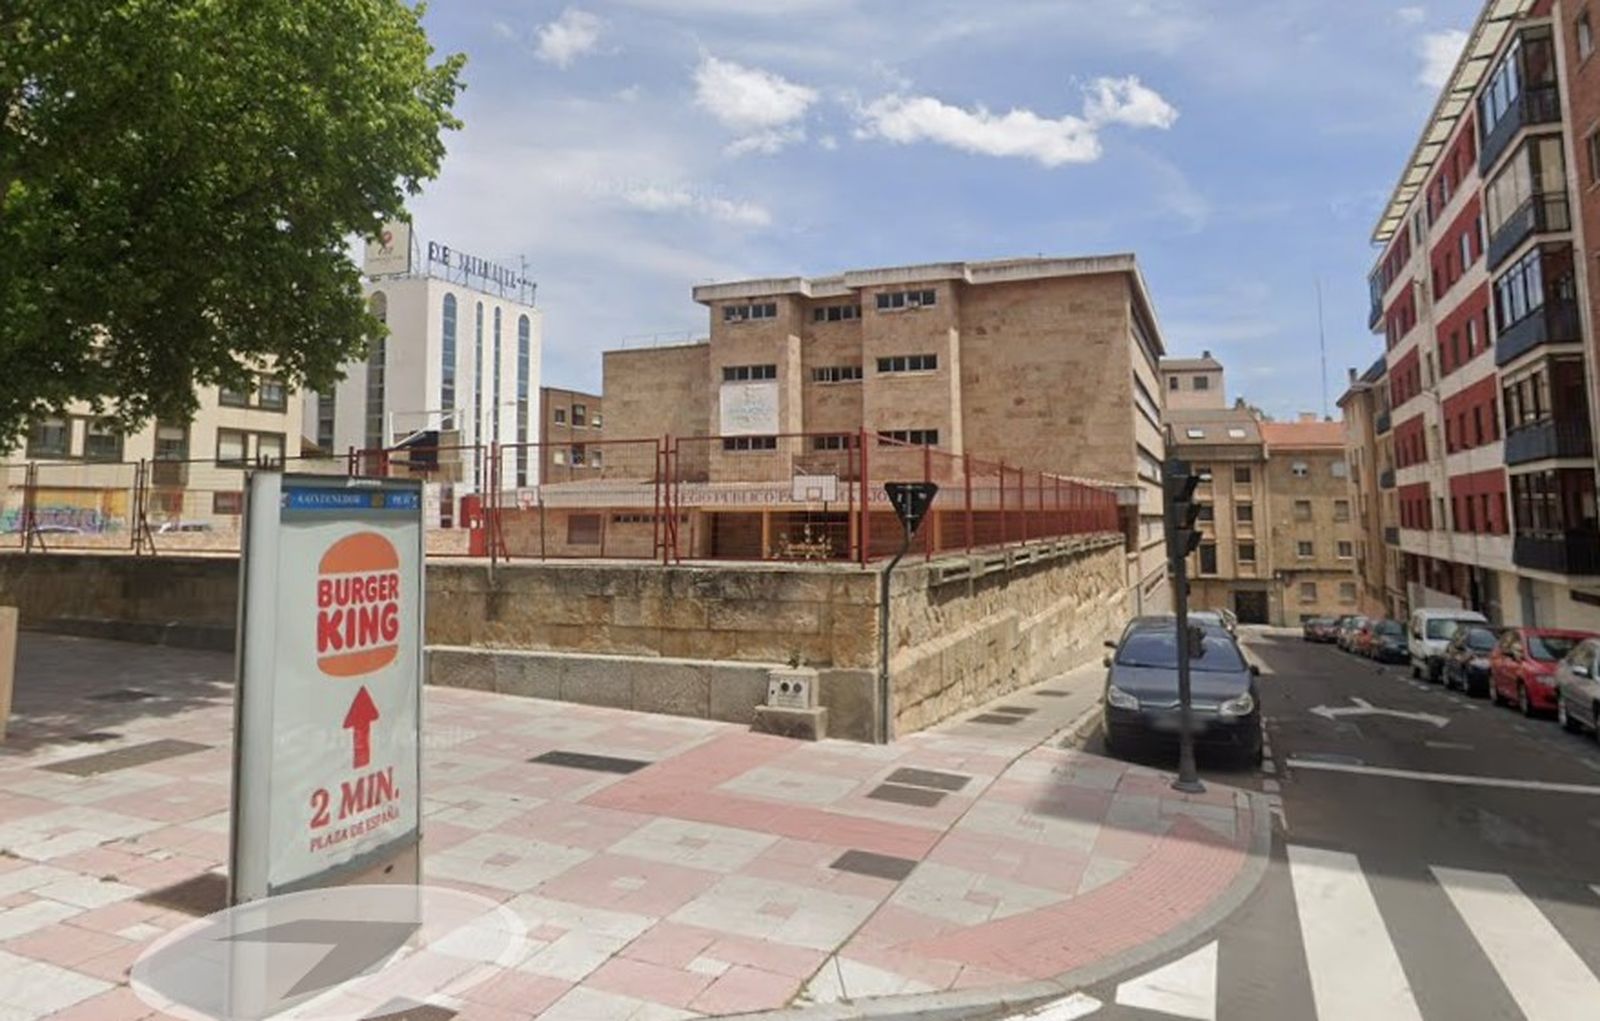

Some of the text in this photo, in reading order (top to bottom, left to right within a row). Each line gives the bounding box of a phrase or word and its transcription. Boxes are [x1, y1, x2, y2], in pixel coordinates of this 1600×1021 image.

[317, 573, 399, 608] BURGER
[317, 602, 399, 653] KING
[310, 766, 400, 829] 2 MIN.
[310, 828, 348, 853] PLAZA
[350, 821, 364, 837] DE
